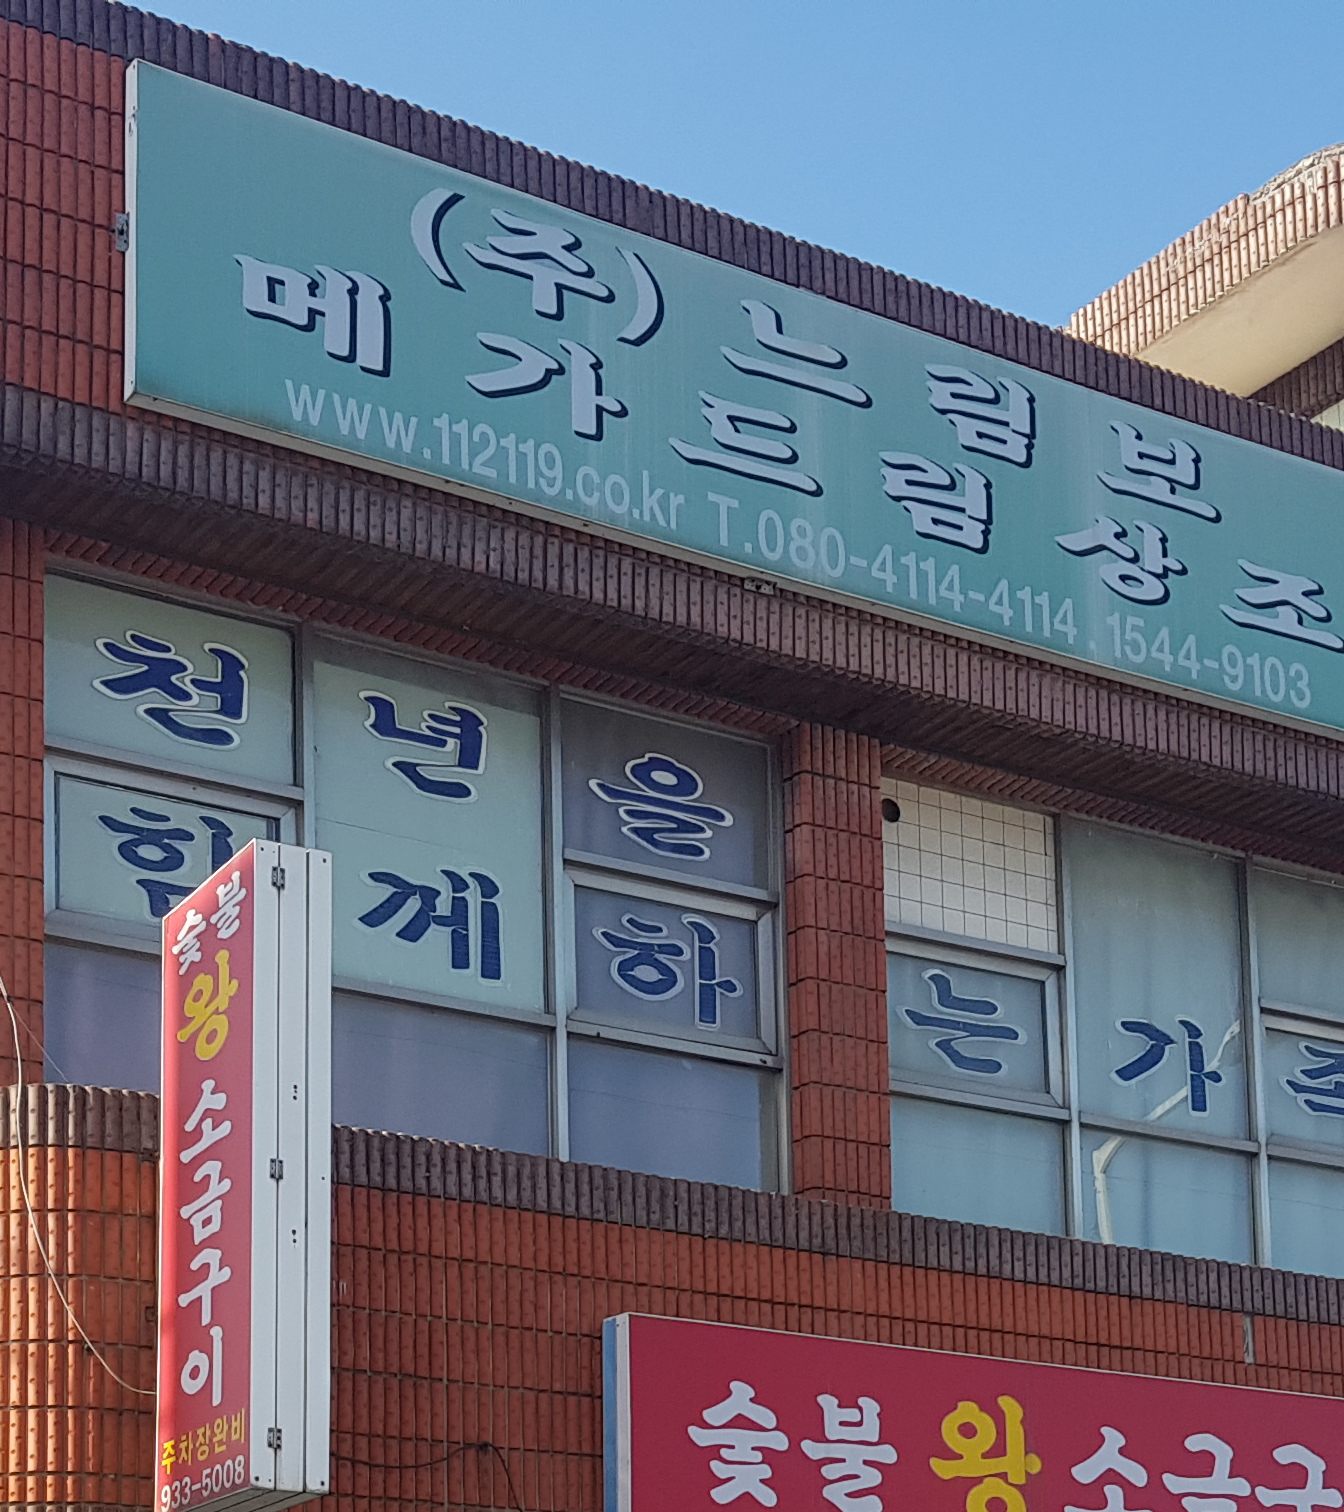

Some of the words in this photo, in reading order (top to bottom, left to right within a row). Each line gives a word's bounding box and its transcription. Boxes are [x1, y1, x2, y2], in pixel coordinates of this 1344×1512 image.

[172, 870, 247, 975] 숯불
[177, 949, 239, 1061] 왕
[178, 1078, 233, 1406] 소금구이
[160, 1454, 245, 1512] 933-5008
[161, 1407, 246, 1475] 주차장완비
